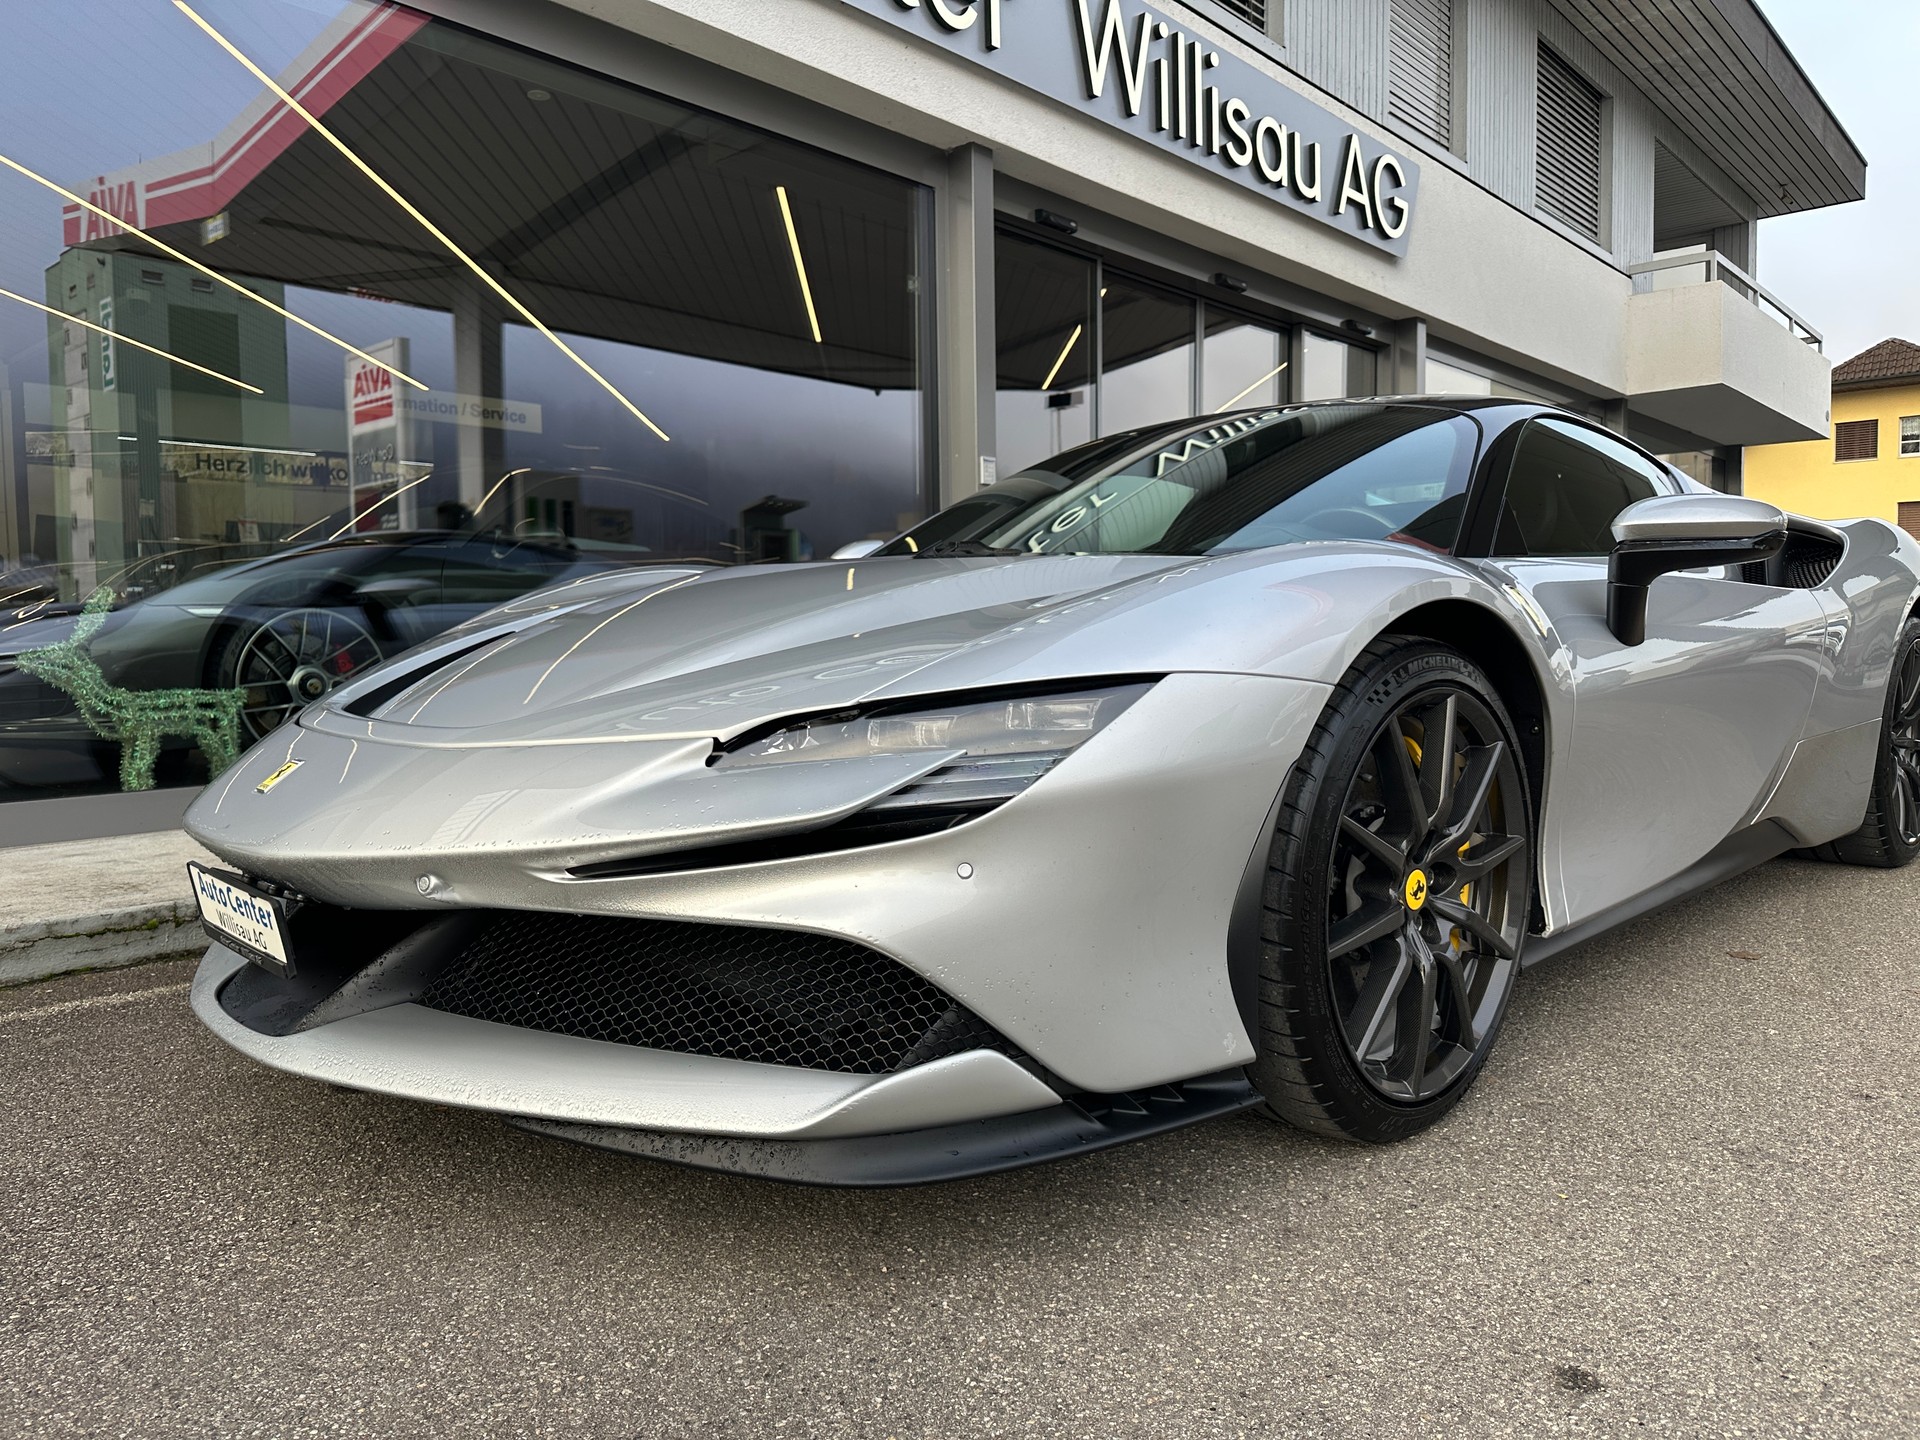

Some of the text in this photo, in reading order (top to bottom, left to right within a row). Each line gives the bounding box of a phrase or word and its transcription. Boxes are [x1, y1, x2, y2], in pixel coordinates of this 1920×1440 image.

[1072, 0, 1410, 240] Willisau AG
[470, 404, 527, 424] Service
[195, 453, 286, 477] Herzlich
[197, 871, 274, 931] AutoCenter
[215, 908, 252, 942] Willisau
[253, 931, 268, 950] AG
